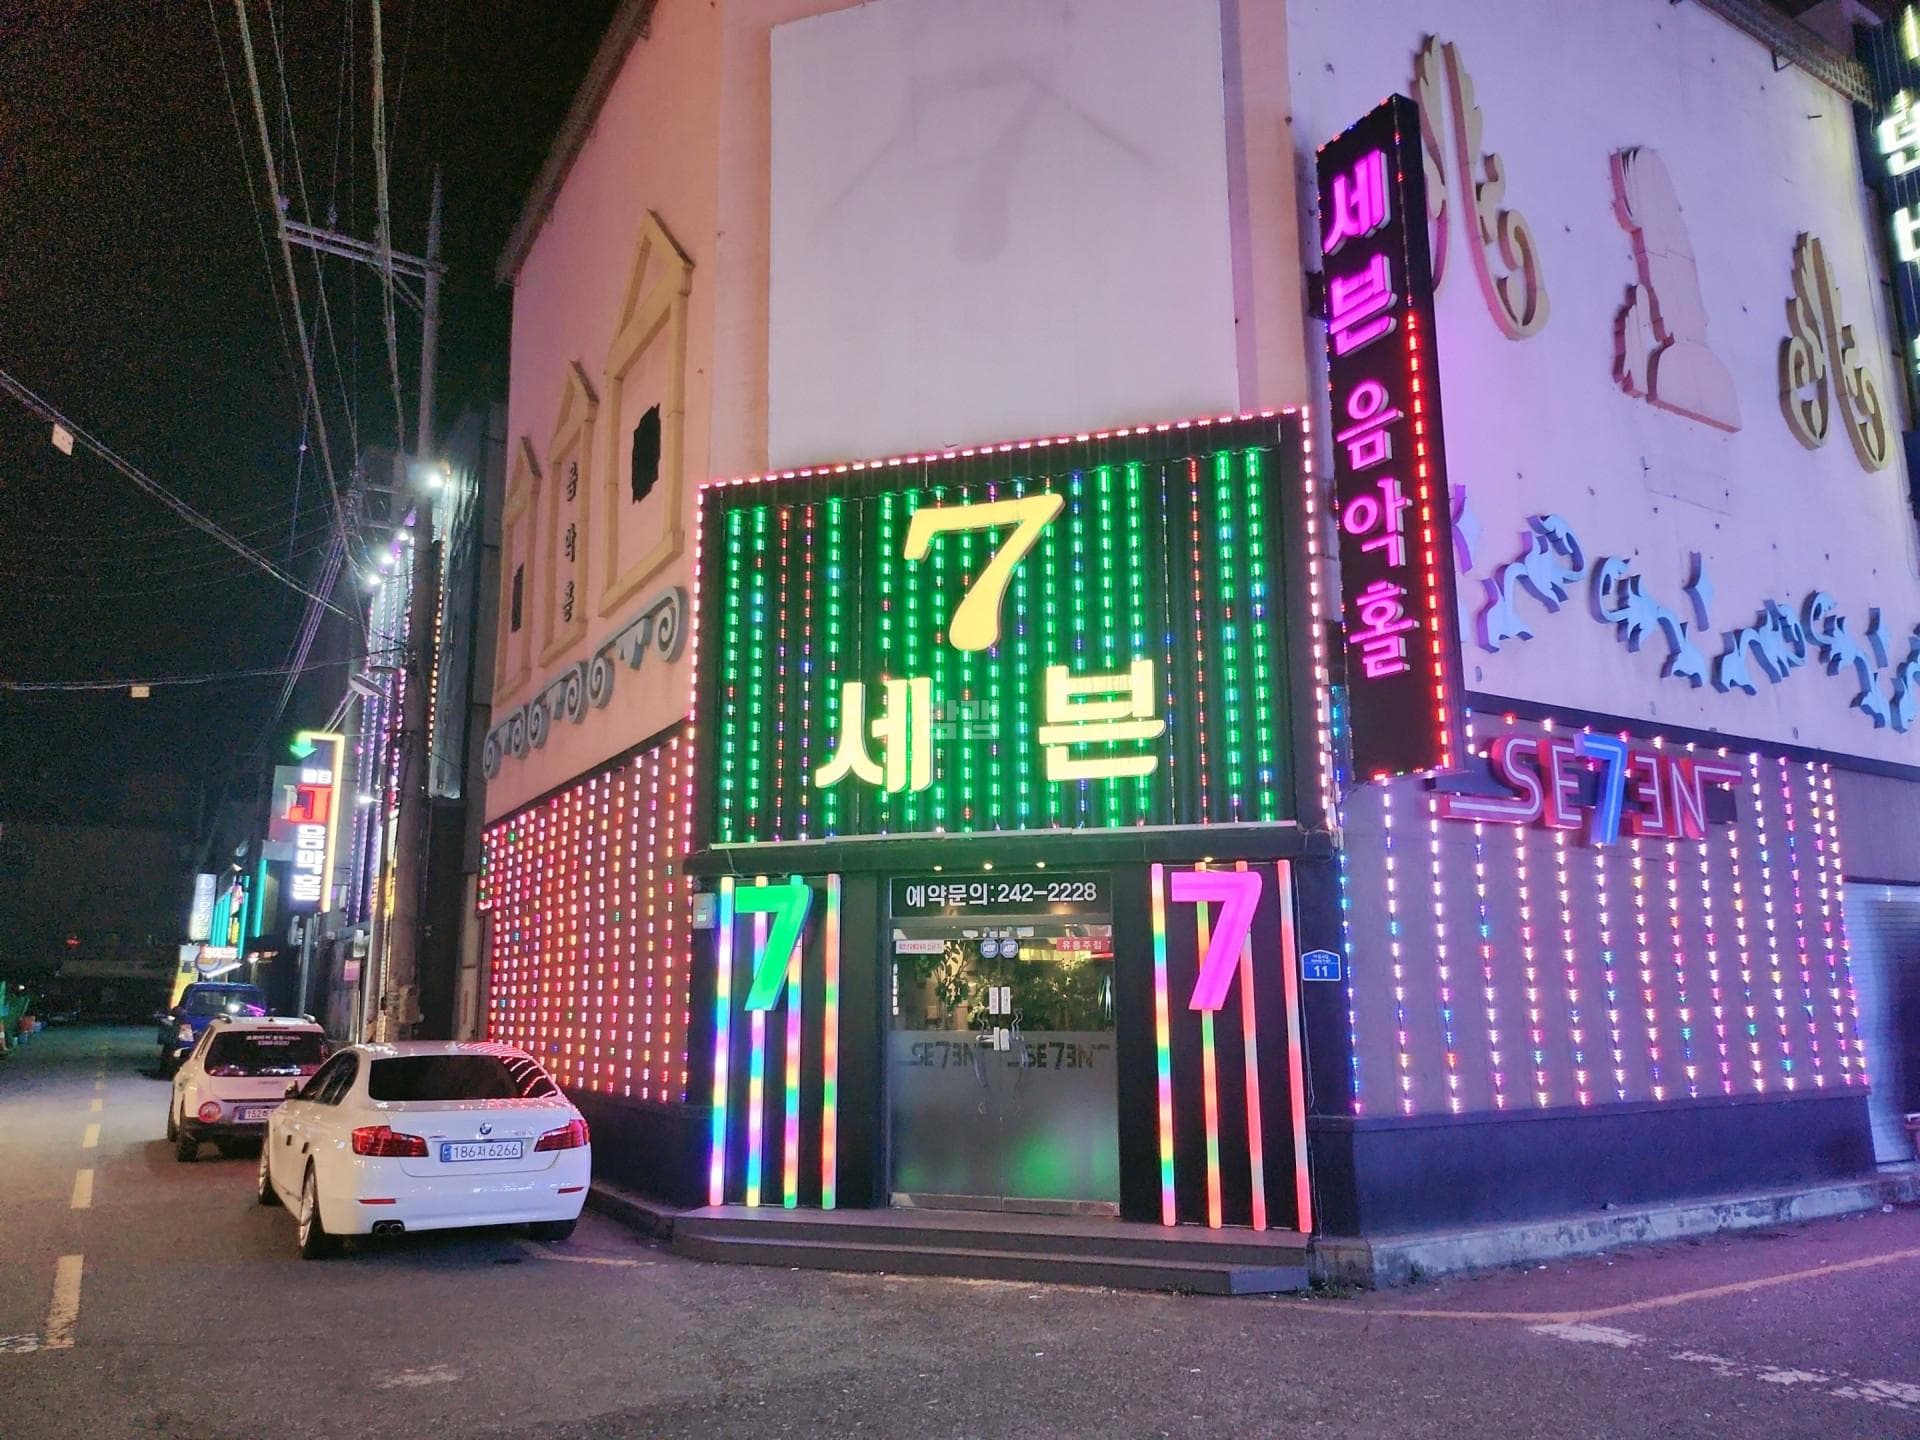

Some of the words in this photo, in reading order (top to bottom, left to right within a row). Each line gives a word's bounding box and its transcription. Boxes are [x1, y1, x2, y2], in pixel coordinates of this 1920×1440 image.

[1323, 148, 1398, 357] 세븐
[903, 493, 1066, 652] 7
[1336, 379, 1420, 681] 음악홀
[815, 659, 1167, 793] 세븐
[735, 884, 813, 1011] 7
[1170, 871, 1263, 1011] 7
[1313, 965, 1328, 977] 11
